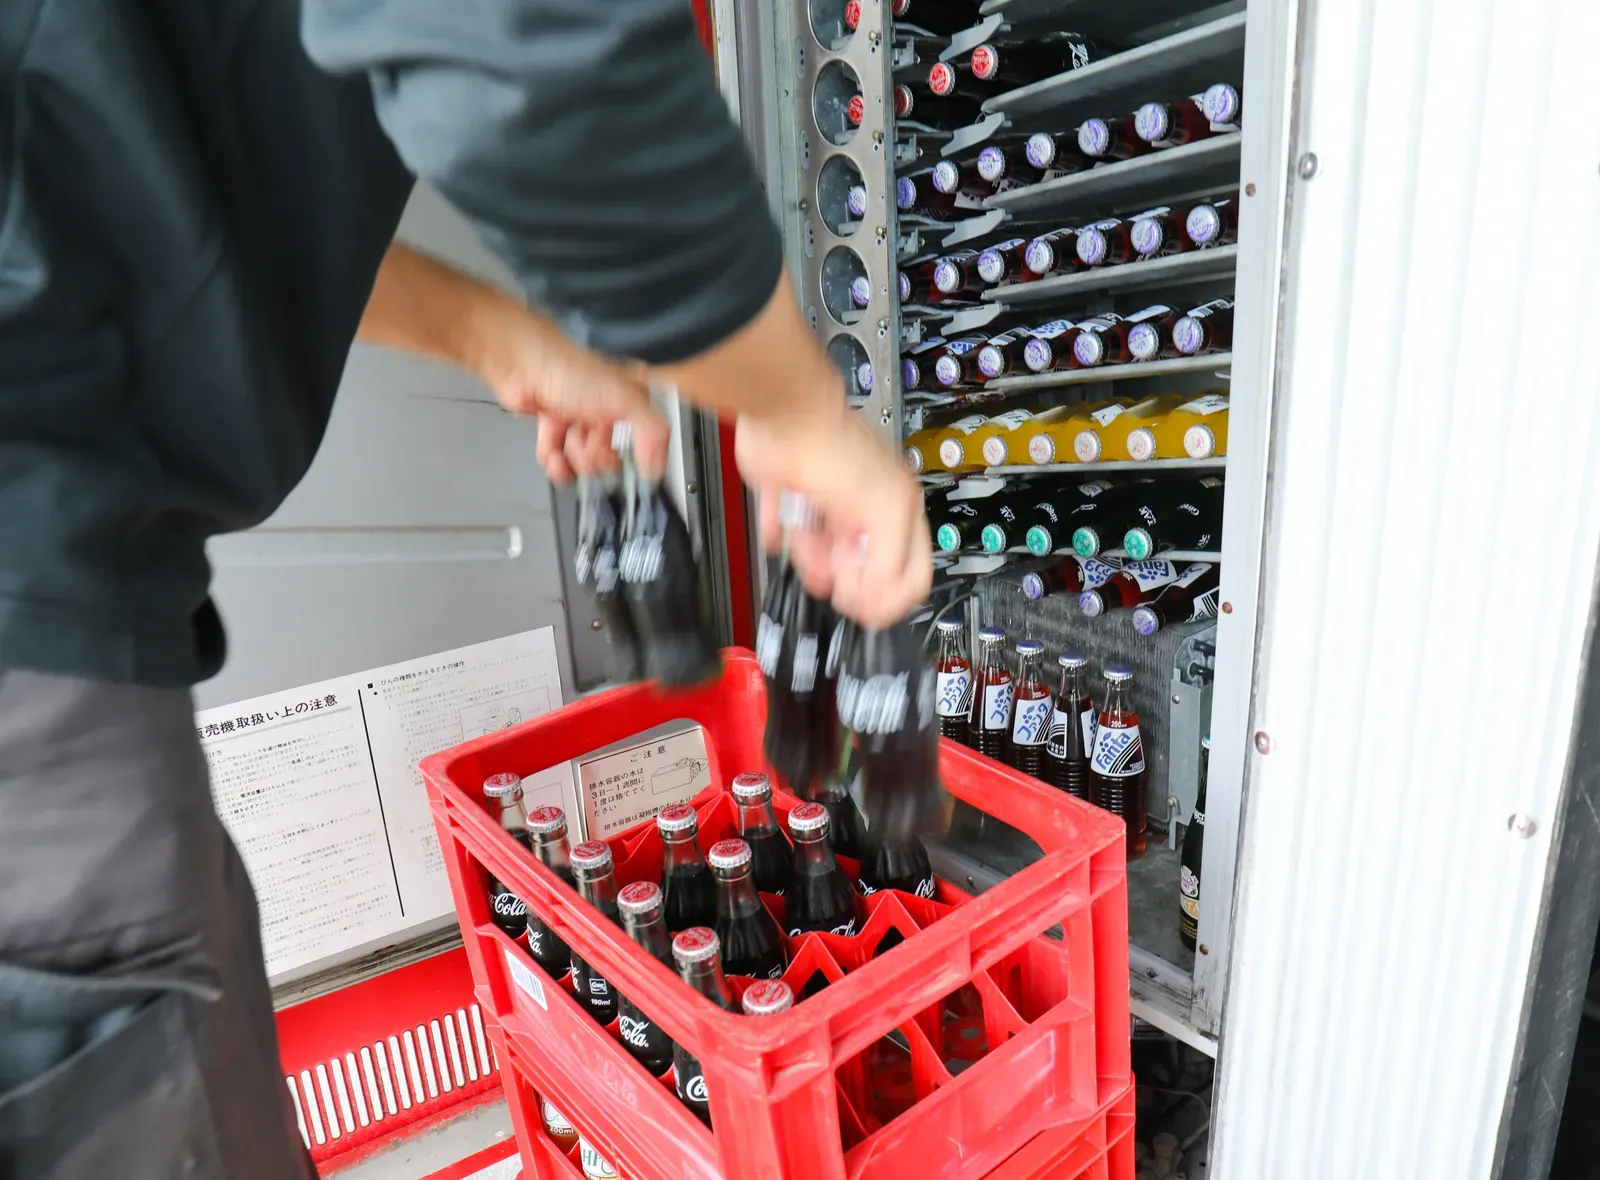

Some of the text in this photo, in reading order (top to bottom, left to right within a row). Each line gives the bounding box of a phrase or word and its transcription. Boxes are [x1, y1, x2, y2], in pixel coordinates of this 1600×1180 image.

[1128, 561, 1170, 578] Fanta
[1095, 732, 1131, 770] Fanta
[589, 767, 644, 791] 排水容器の水は
[594, 805, 617, 817] ださい
[591, 998, 611, 1006] 190ml
[549, 1125, 574, 1134] 200ml
